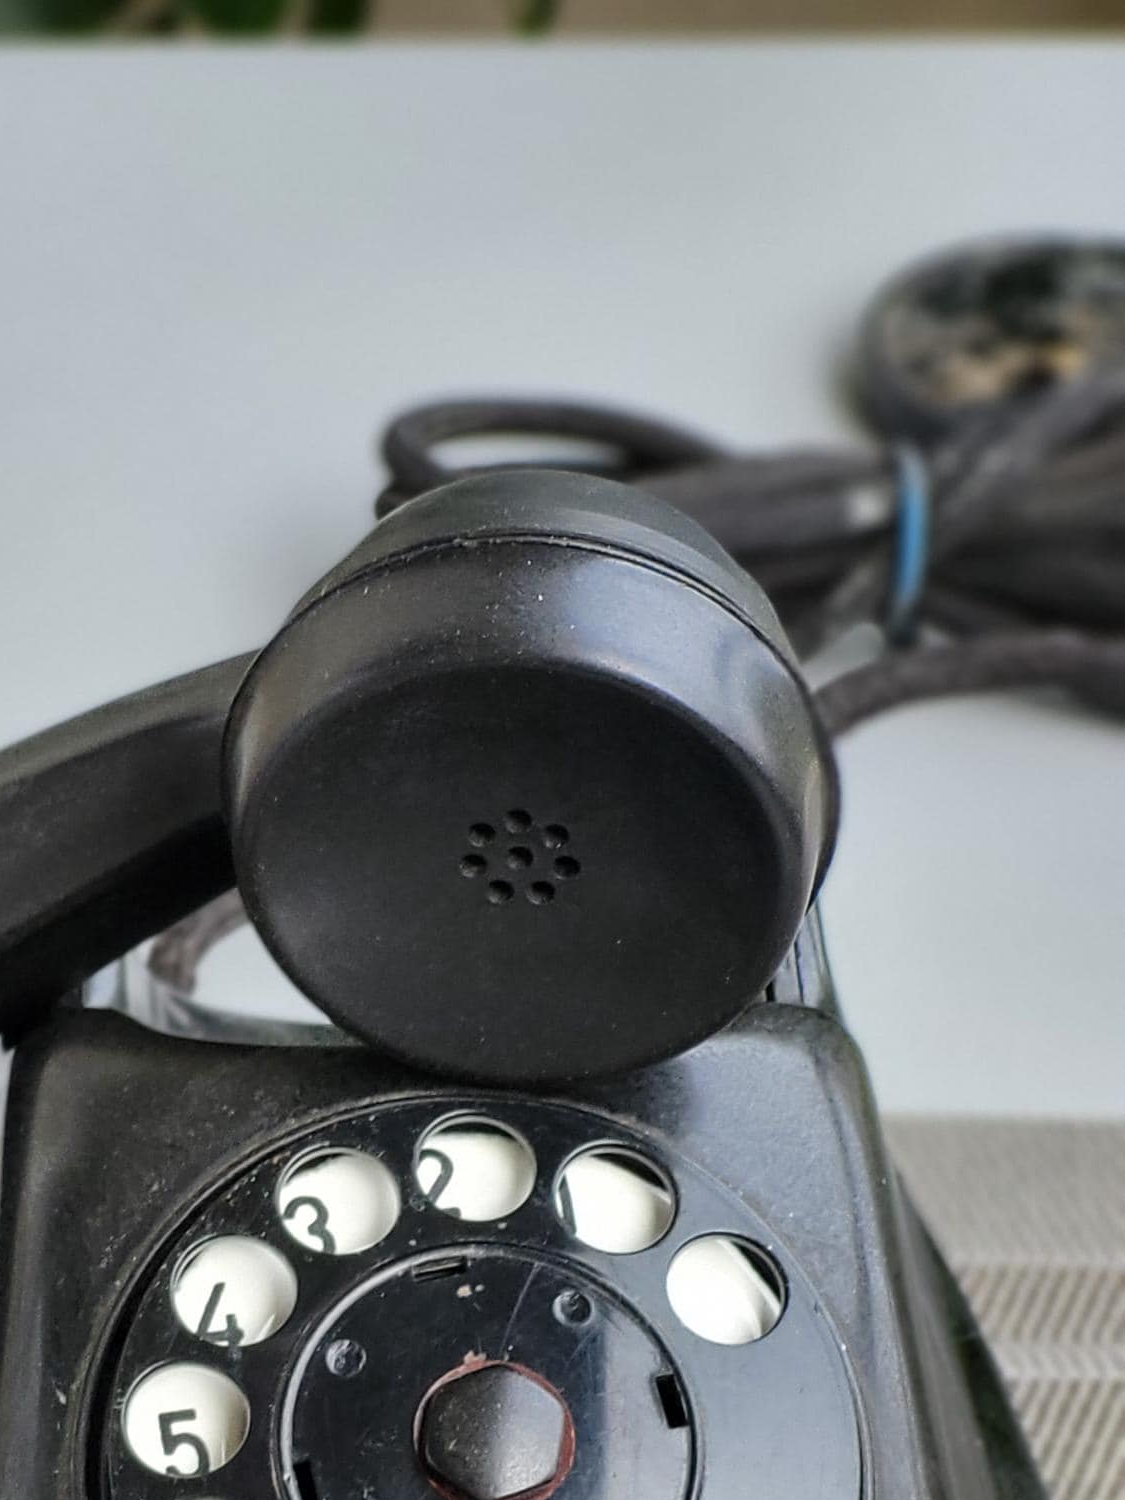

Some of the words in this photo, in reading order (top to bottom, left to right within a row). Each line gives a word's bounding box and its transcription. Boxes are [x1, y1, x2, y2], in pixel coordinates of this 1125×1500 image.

[418, 1147, 461, 1219] 2
[283, 1195, 336, 1254] 3
[196, 1281, 245, 1347] 4
[158, 1408, 210, 1476] 5
